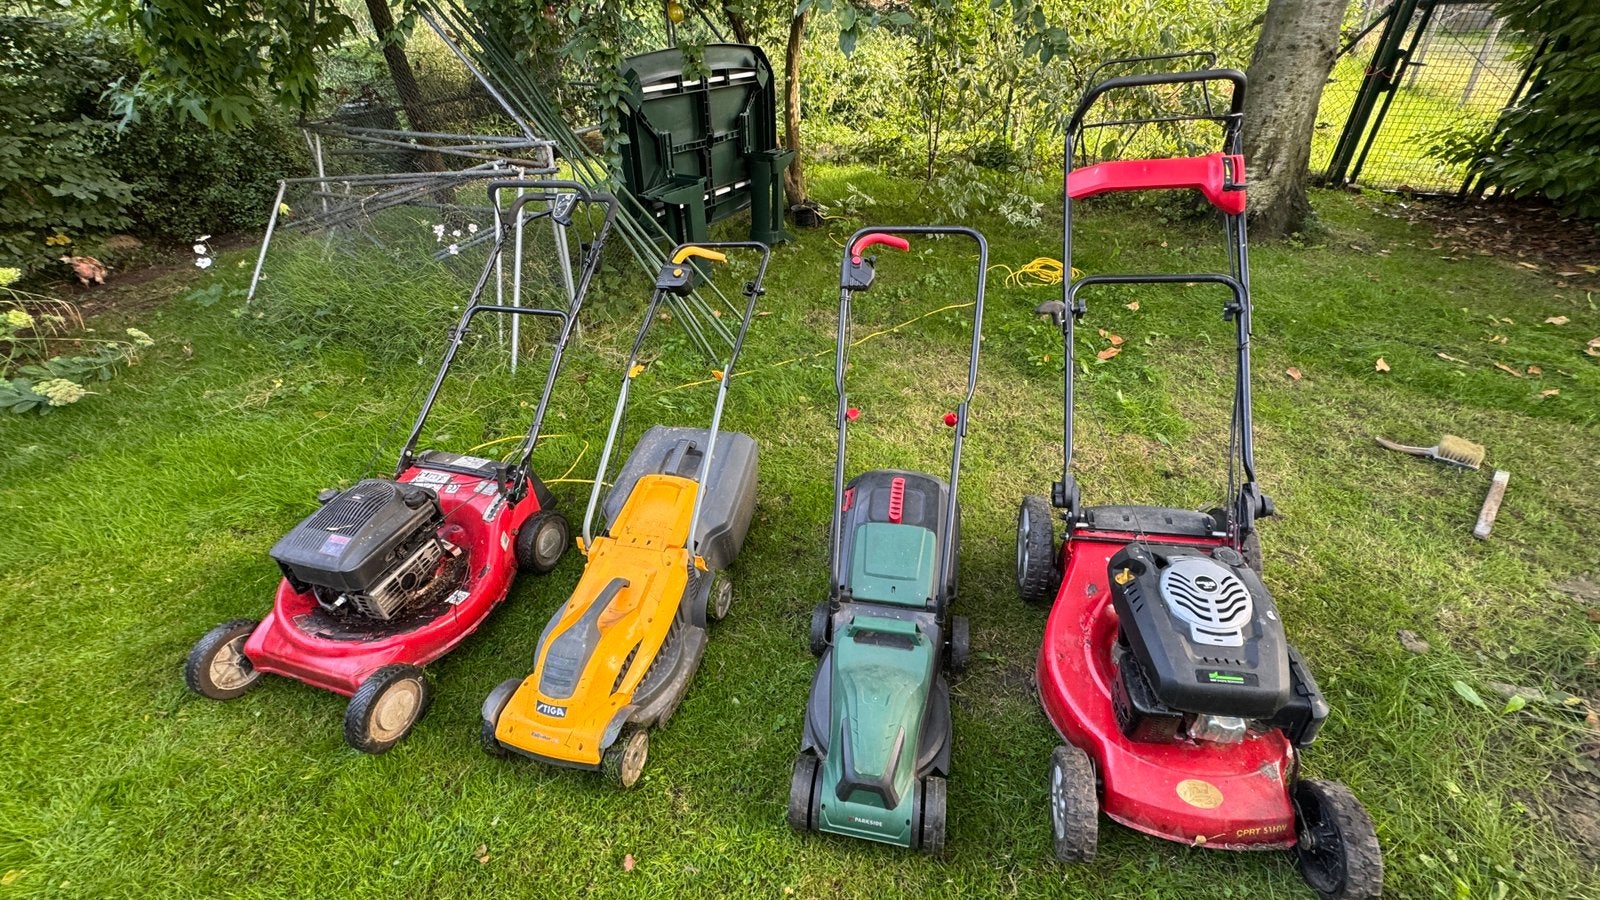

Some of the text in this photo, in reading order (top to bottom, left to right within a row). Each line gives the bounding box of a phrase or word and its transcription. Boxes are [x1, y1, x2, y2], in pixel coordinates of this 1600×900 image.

[537, 704, 564, 716] STIGA
[854, 816, 882, 827] PARKSIDE
[1236, 827, 1261, 837] CPRT
